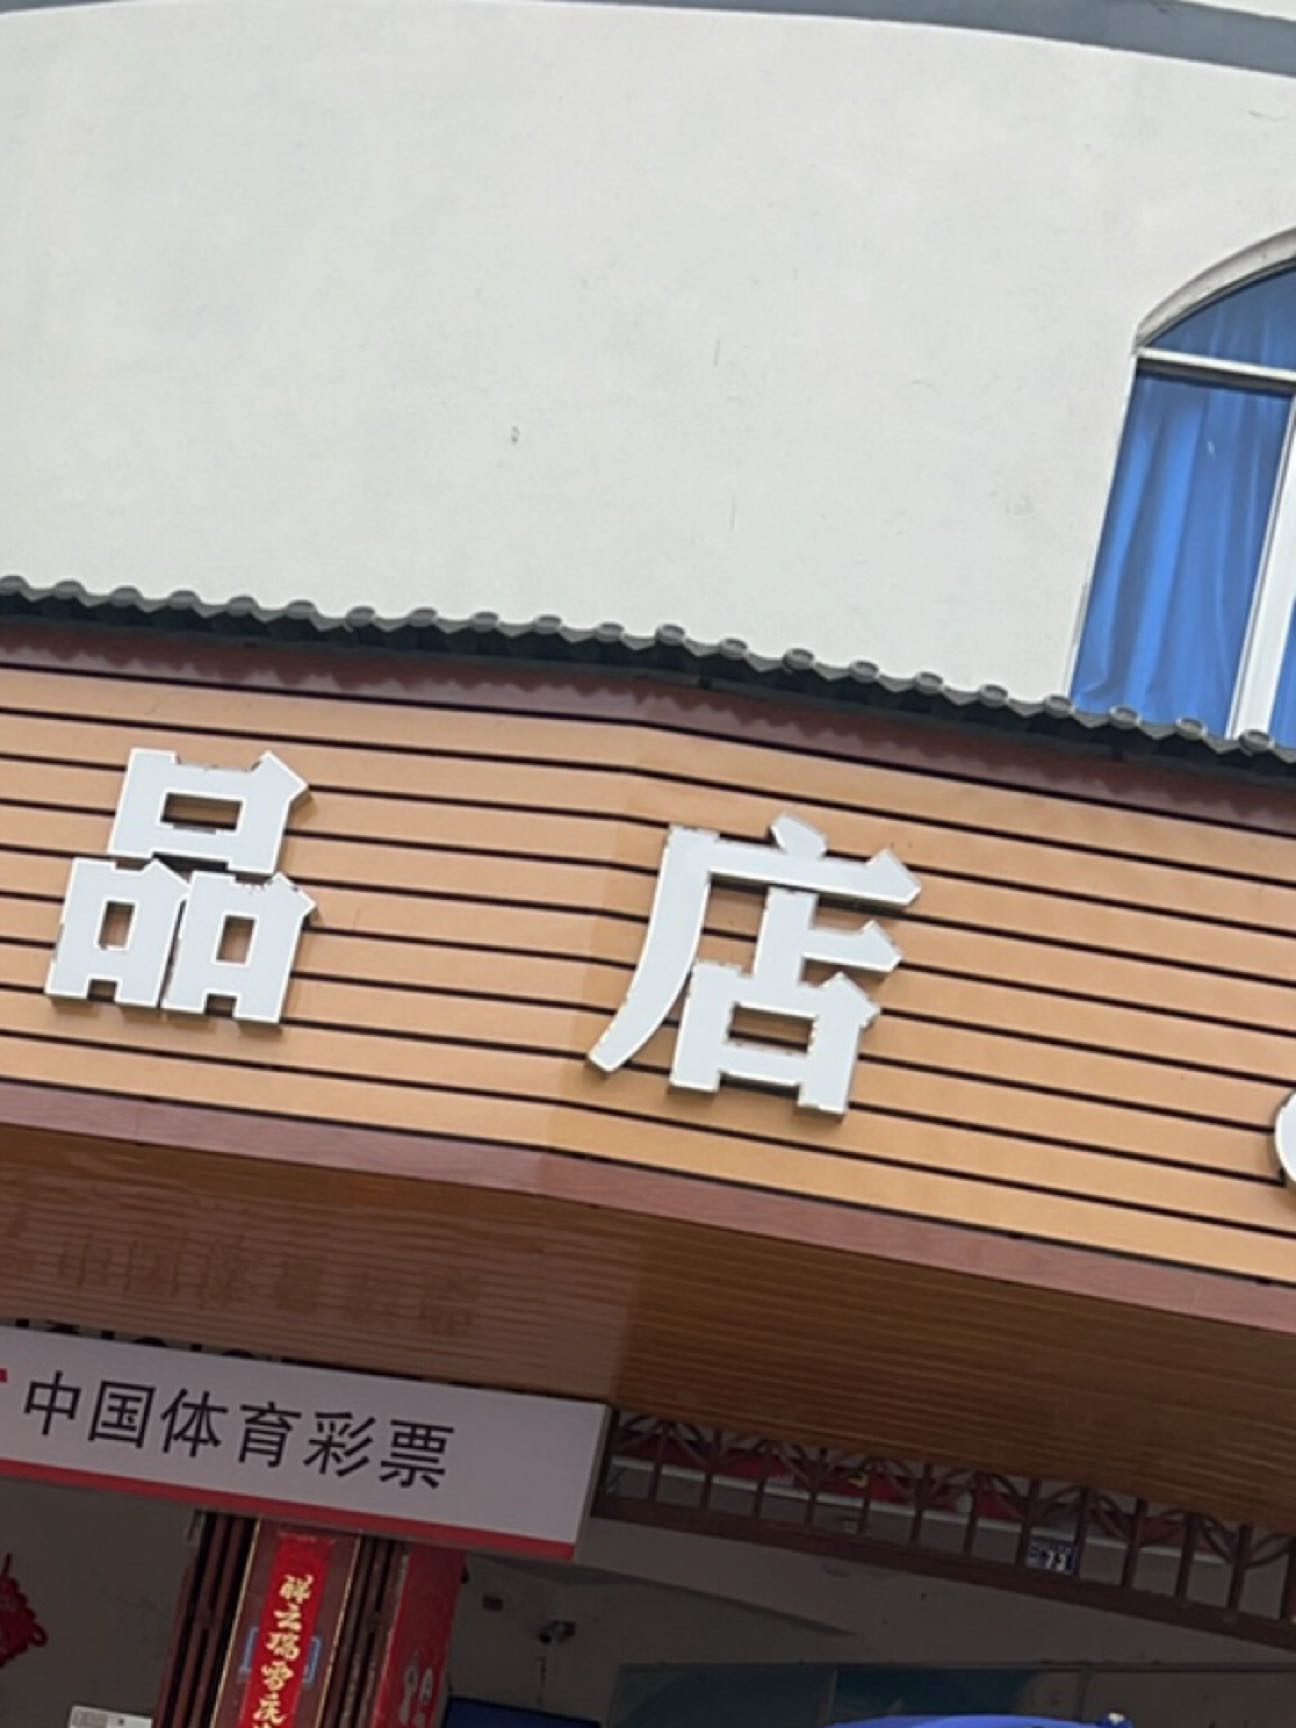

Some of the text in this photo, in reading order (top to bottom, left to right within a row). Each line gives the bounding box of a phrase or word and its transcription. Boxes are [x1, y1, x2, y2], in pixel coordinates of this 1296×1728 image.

[24, 1370, 454, 1489] 中国体育彩票
